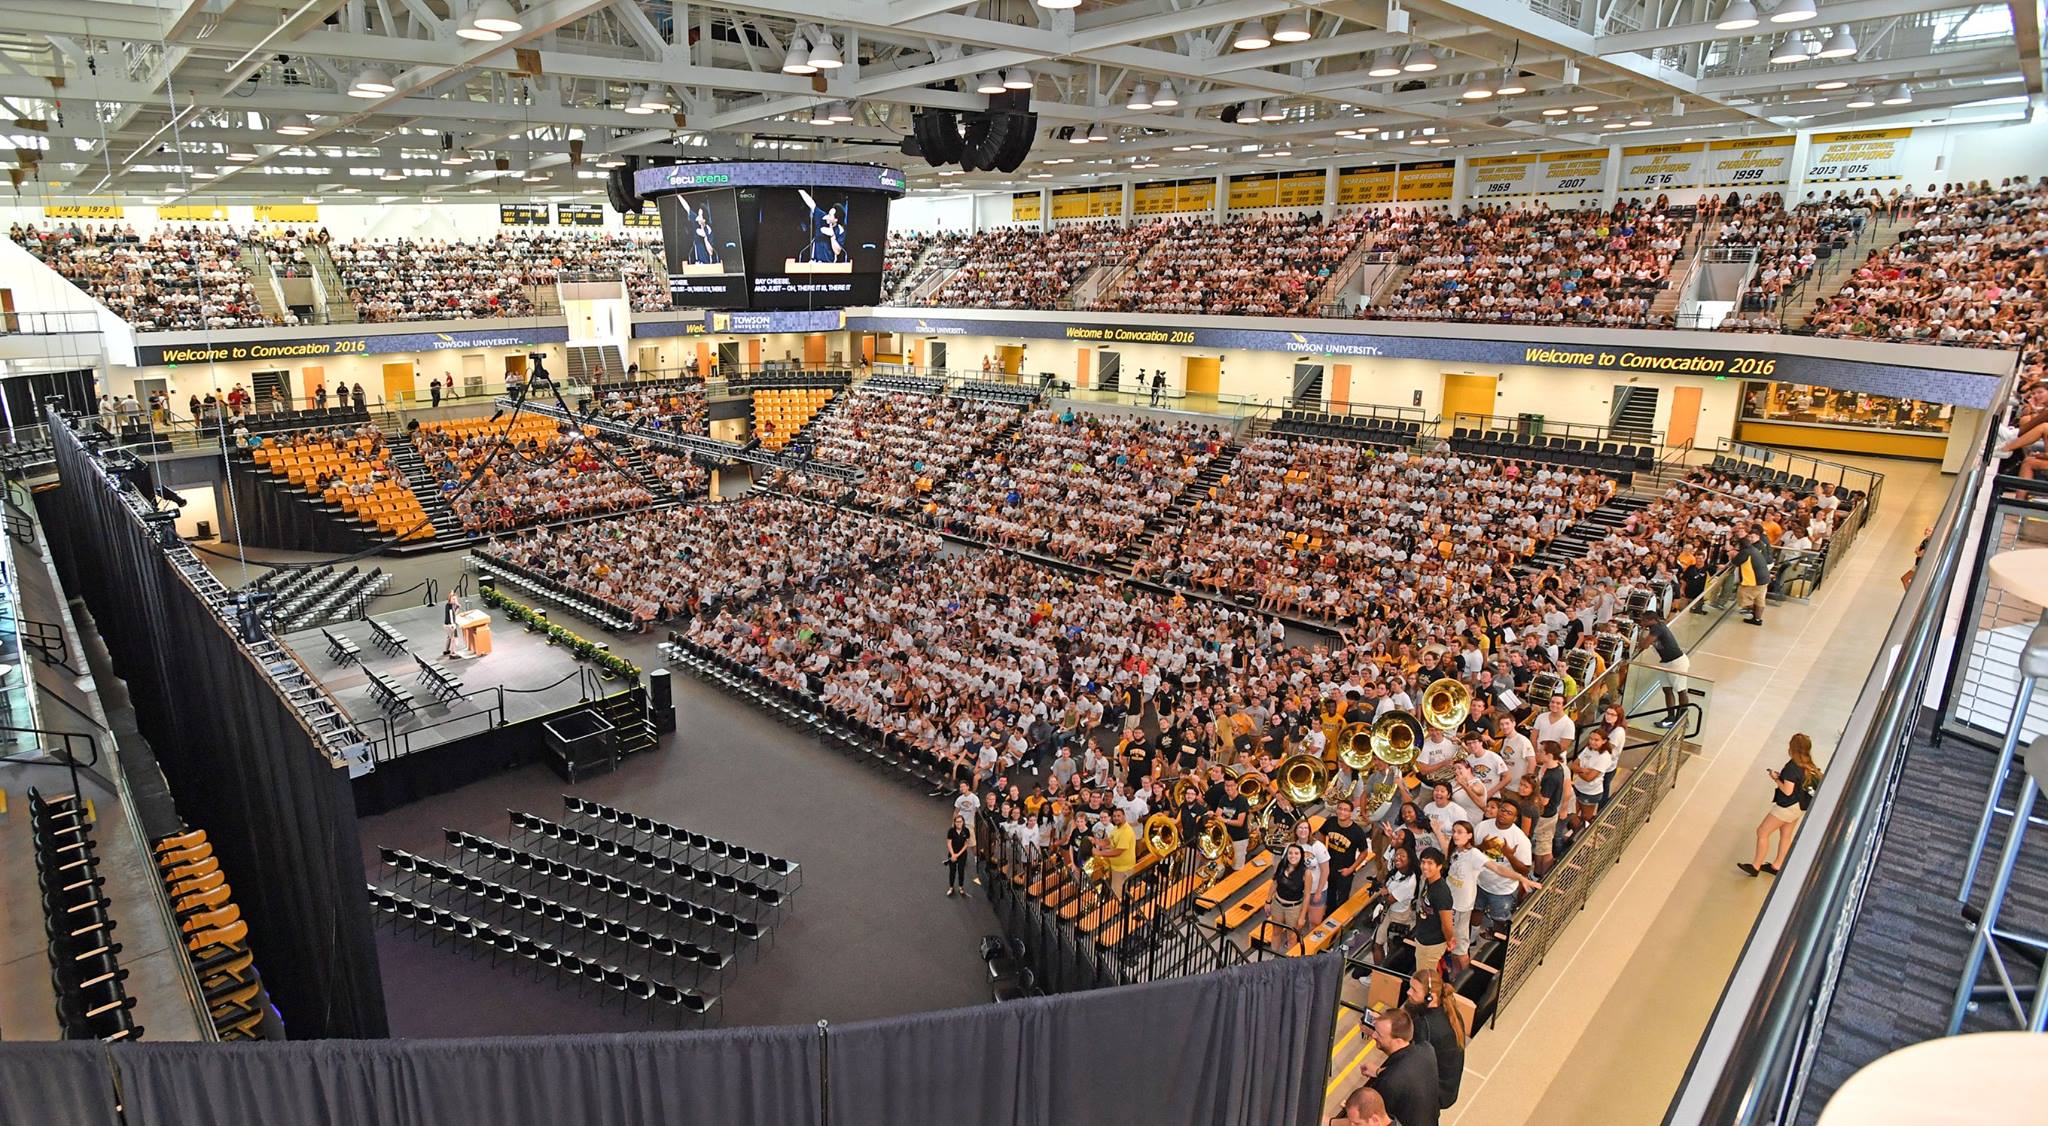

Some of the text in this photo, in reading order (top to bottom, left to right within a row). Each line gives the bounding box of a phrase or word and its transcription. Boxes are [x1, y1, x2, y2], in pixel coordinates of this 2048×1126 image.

[1819, 150, 1896, 162] CHAMPIONS
[1631, 163, 1692, 175] CHAMPIONS
[1716, 158, 1784, 170] CHAMPIONS
[1732, 169, 1764, 180] 1999
[1809, 166, 1837, 175] 2013
[695, 174, 729, 184] arena
[1558, 178, 1586, 188] 2007
[1487, 183, 1512, 192] 1969
[733, 316, 770, 324] TOWSON
[1066, 327, 1195, 343] Welcome to Convocation 2016
[432, 337, 519, 349] TOWSON UNIVERSITY
[1286, 342, 1378, 355] TOWSON UNIVERSITY
[163, 341, 366, 362] Welcome to Convocation 2016
[1525, 348, 1777, 375] Welcome to Convocation 2016
